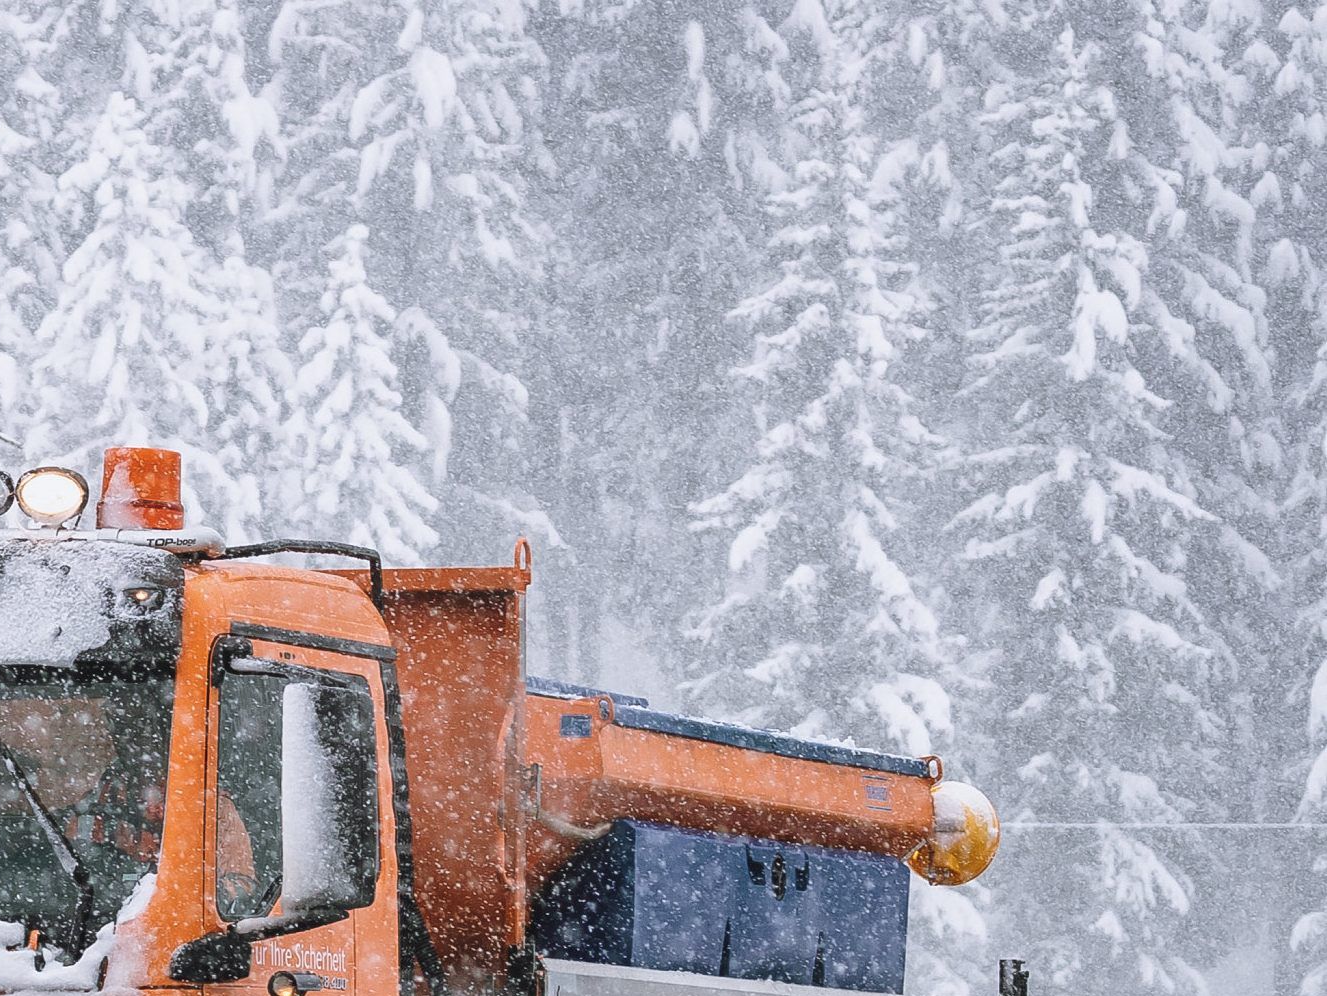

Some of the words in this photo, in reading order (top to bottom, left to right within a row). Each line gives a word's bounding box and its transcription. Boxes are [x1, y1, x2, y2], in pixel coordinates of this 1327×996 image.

[251, 941, 268, 966] ür
[270, 941, 292, 968] Ihre
[295, 943, 347, 972] Sicherheit
